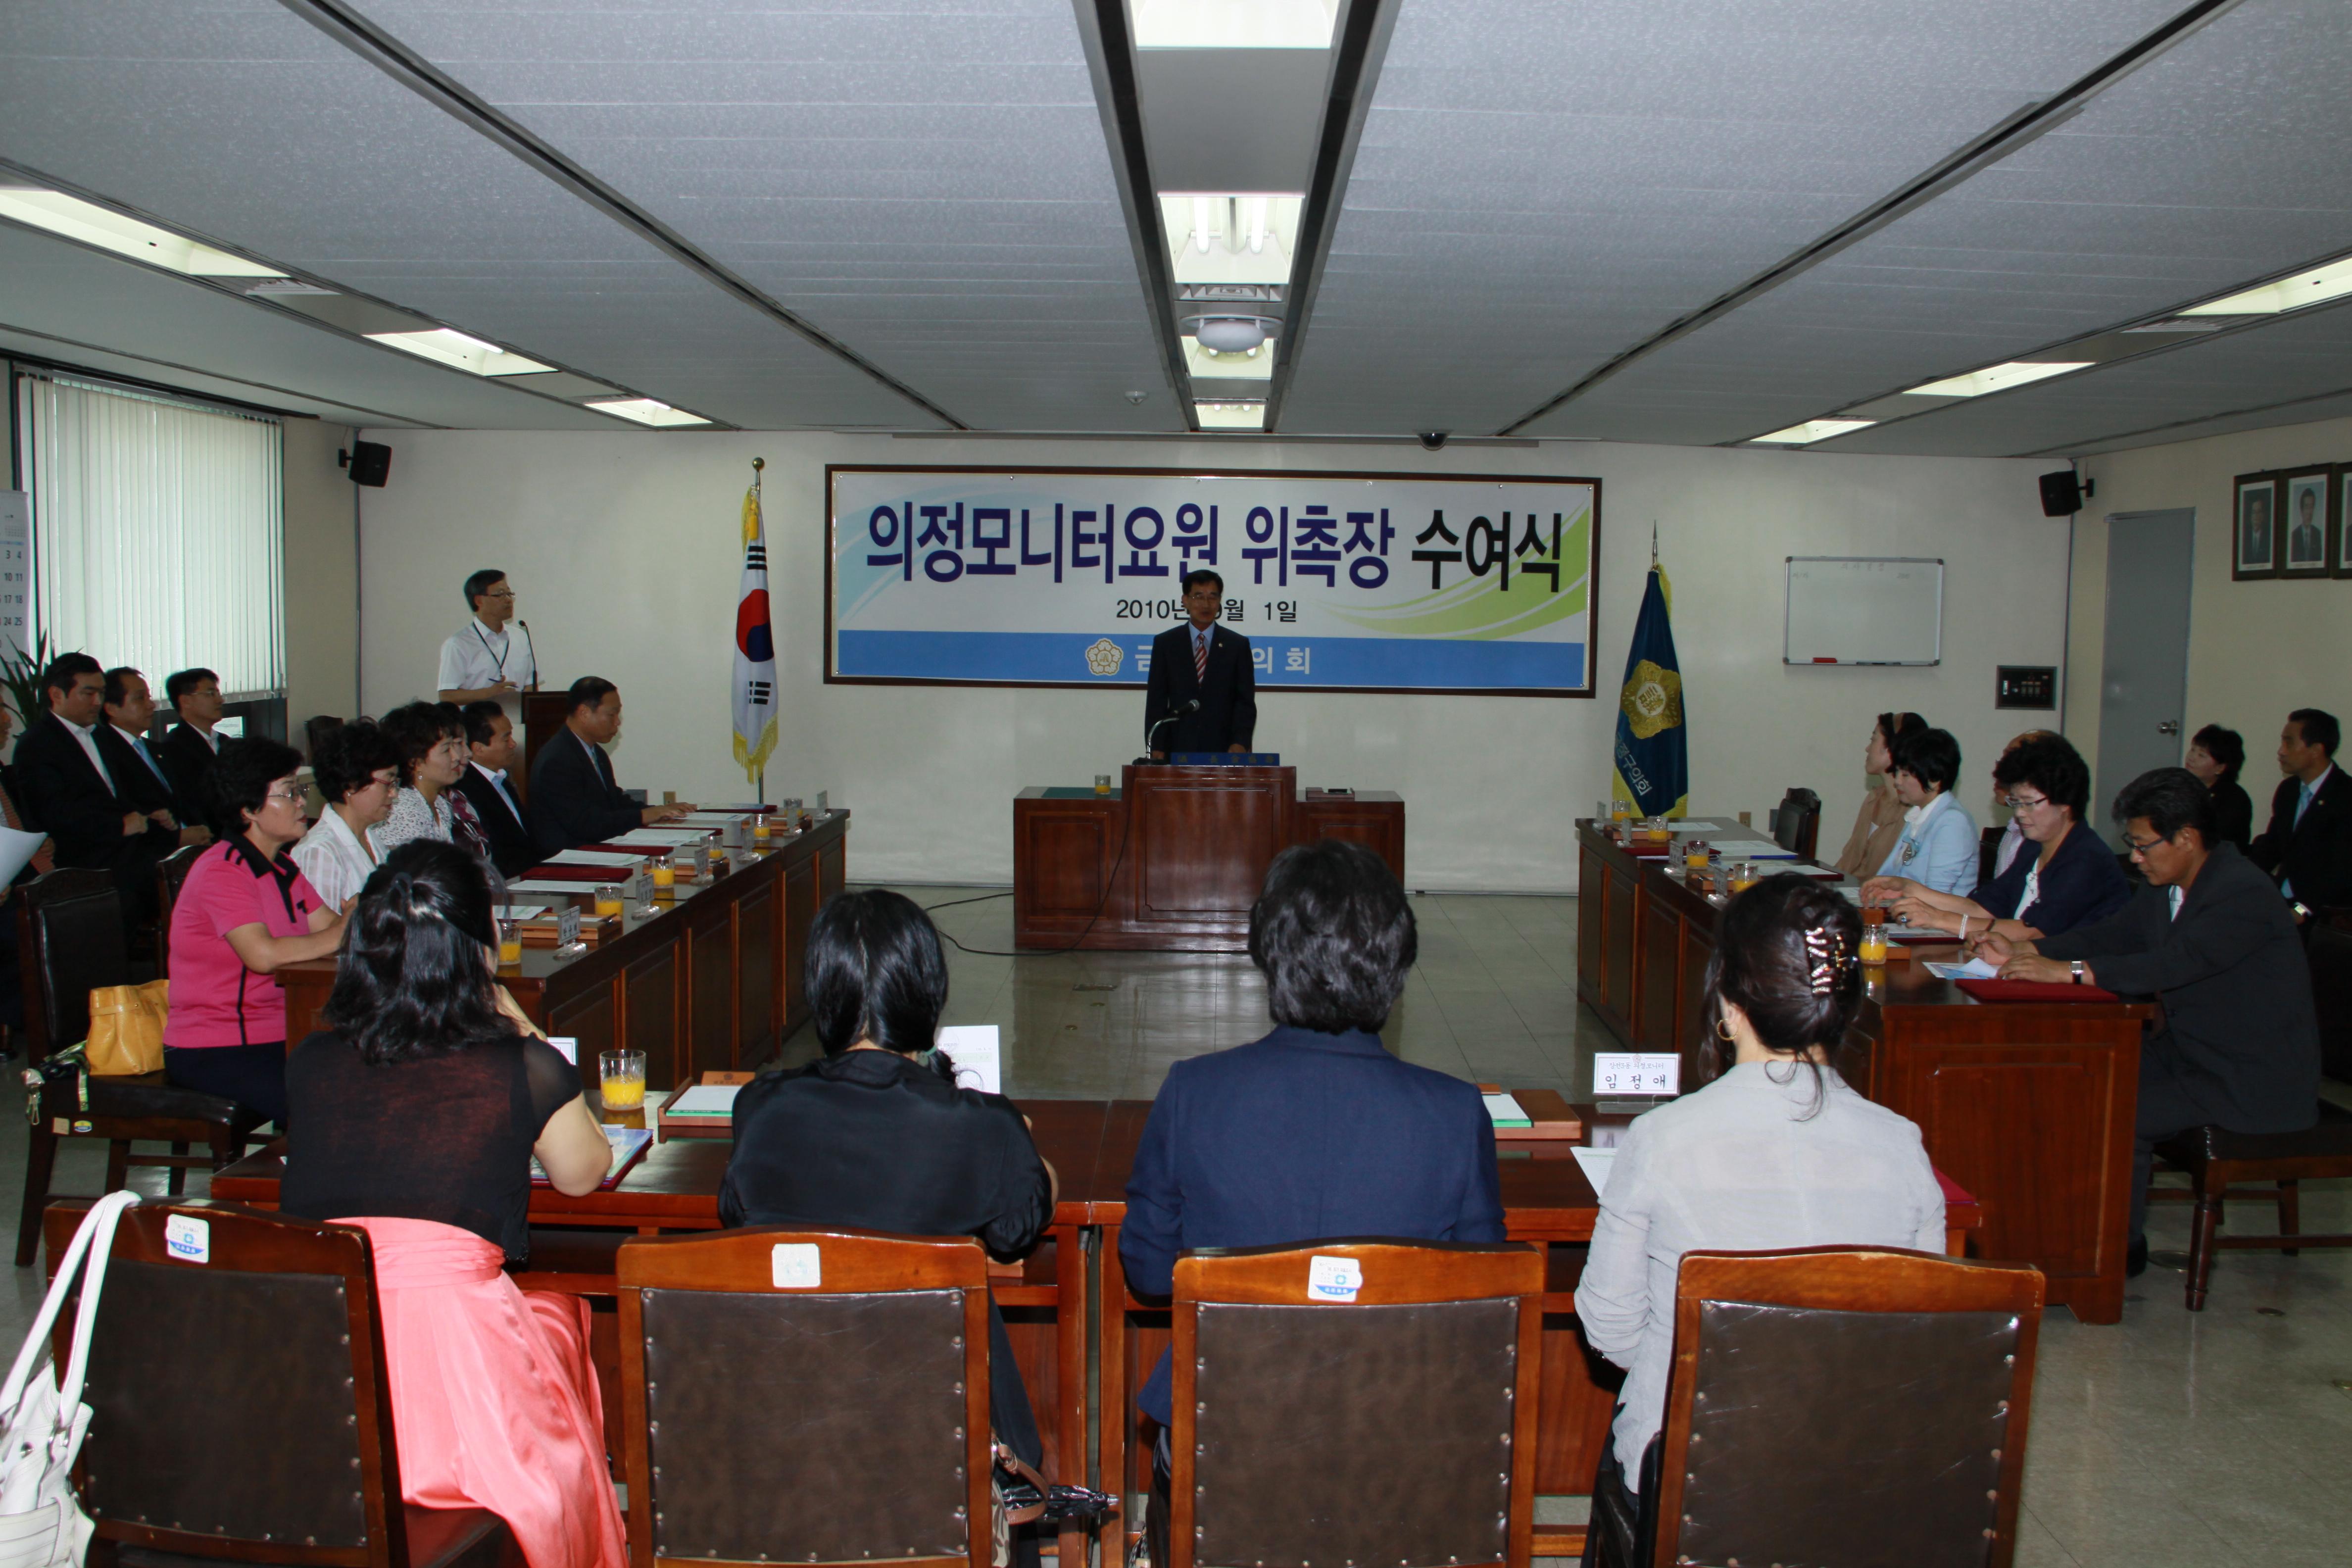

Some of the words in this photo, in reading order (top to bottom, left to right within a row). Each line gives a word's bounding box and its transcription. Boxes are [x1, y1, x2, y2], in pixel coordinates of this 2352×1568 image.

[867, 501, 1218, 583] 의정모니터요원
[1242, 505, 1395, 589] 위촉장
[1412, 510, 1562, 593] 수여식
[4, 573, 12, 581] 10
[1215, 599, 1244, 622] 월
[1264, 601, 1296, 622] 1일
[14, 617, 22, 626] 25
